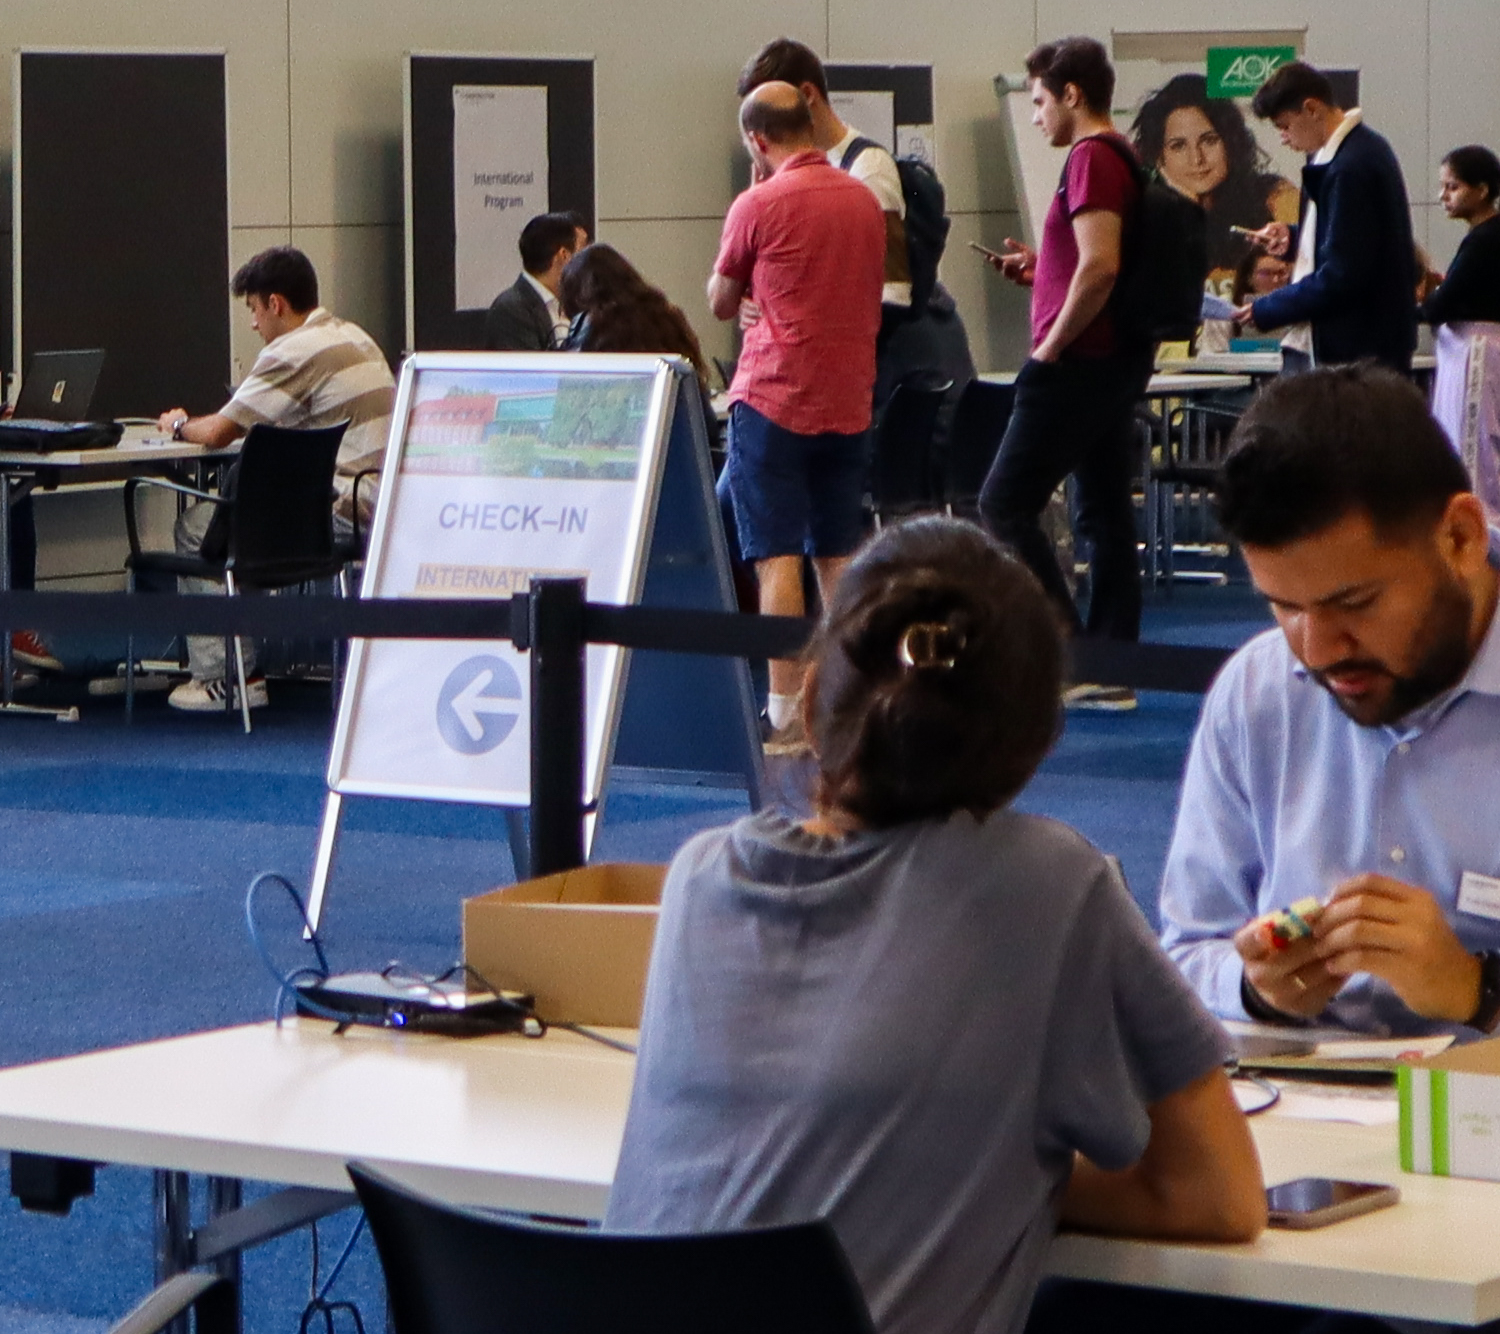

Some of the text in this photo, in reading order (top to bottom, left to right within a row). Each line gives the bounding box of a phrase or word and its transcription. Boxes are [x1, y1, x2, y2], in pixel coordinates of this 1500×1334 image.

[1222, 54, 1281, 81] AOK
[473, 171, 534, 186] International
[484, 195, 524, 210] Program
